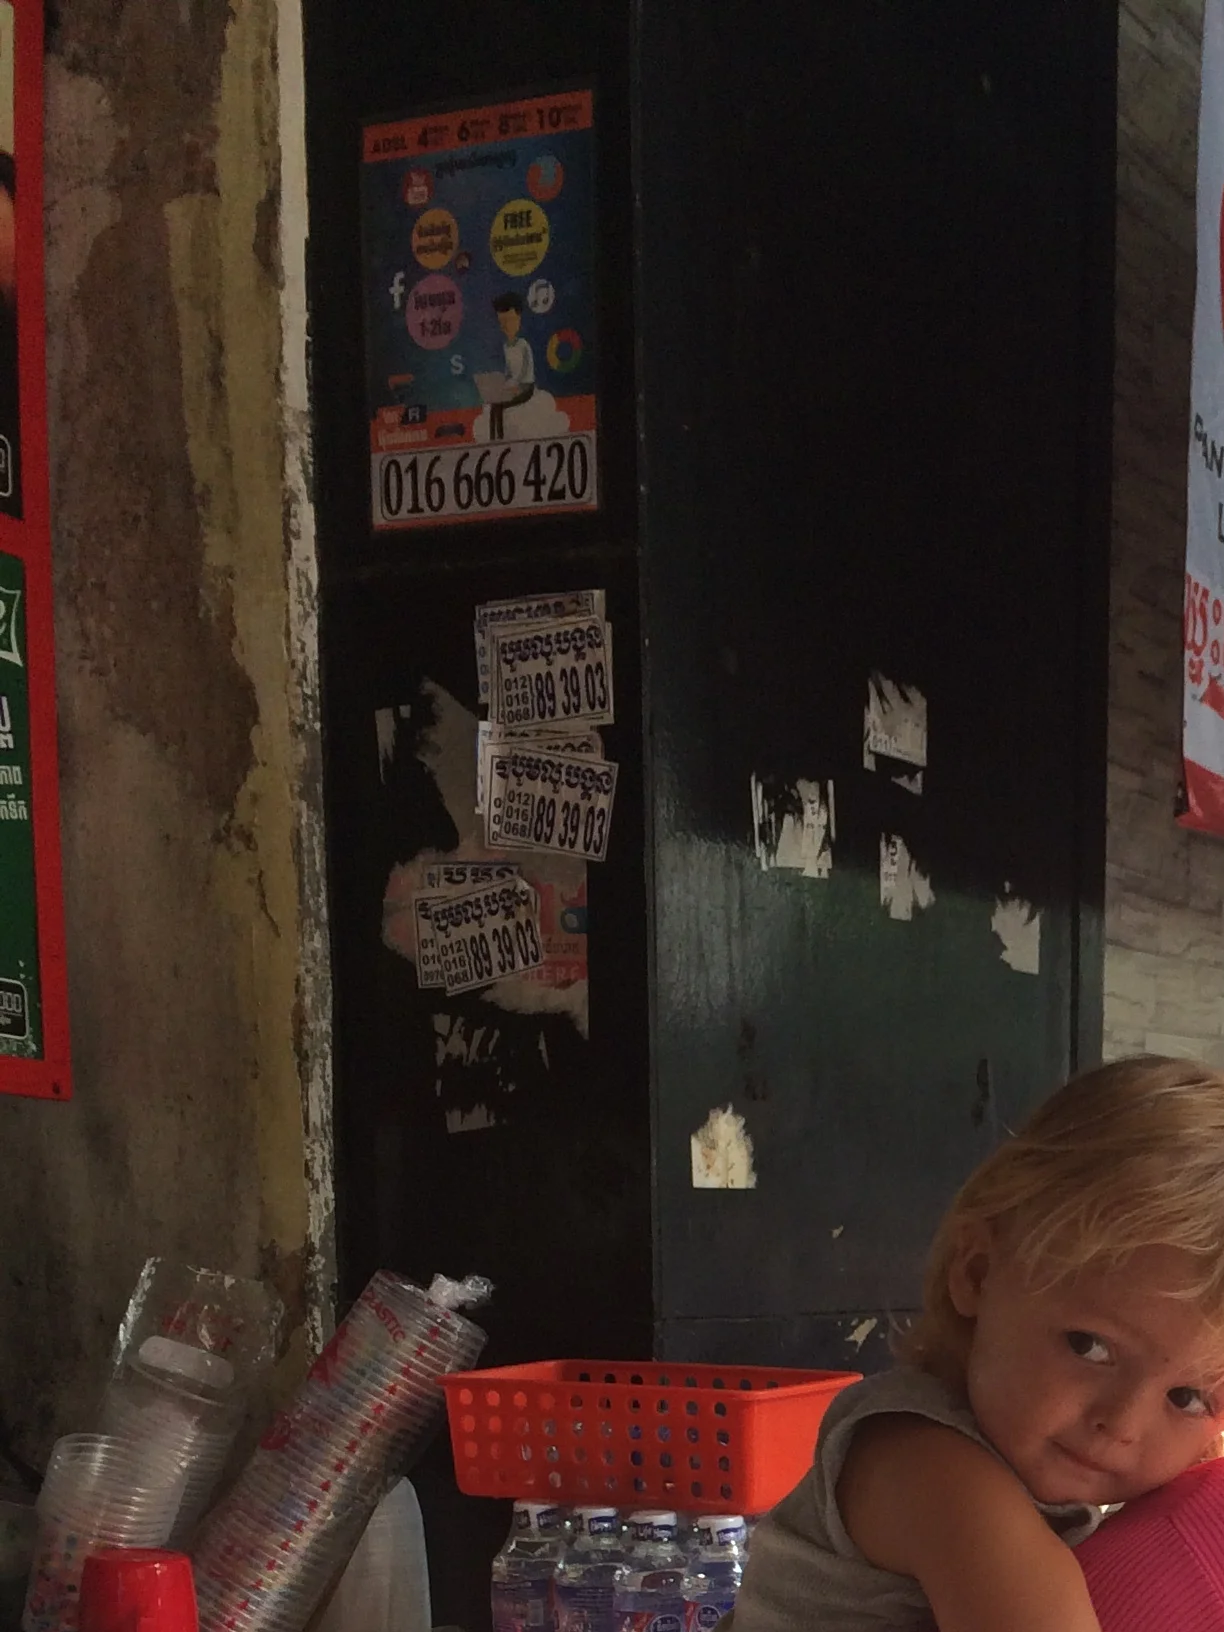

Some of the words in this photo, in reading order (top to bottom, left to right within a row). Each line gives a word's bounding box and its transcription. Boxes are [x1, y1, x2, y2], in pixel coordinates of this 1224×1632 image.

[384, 455, 445, 516] 016
[454, 448, 515, 510] 666
[523, 441, 588, 503] 420
[503, 676, 529, 692] 012
[534, 670, 557, 720] 89
[559, 667, 581, 715] 39
[584, 661, 608, 711] 03
[505, 691, 530, 708] 016
[506, 707, 531, 723] 068
[507, 790, 531, 806] 012
[505, 806, 529, 822] 016
[503, 822, 528, 838] 068
[533, 796, 557, 846] 89
[558, 801, 581, 850] 39
[583, 806, 606, 855] 03
[440, 939, 464, 957] 012
[470, 932, 492, 979] 89
[492, 925, 515, 973] 39
[515, 918, 540, 966] 03
[444, 956, 467, 972] 016
[446, 971, 469, 987] 068
